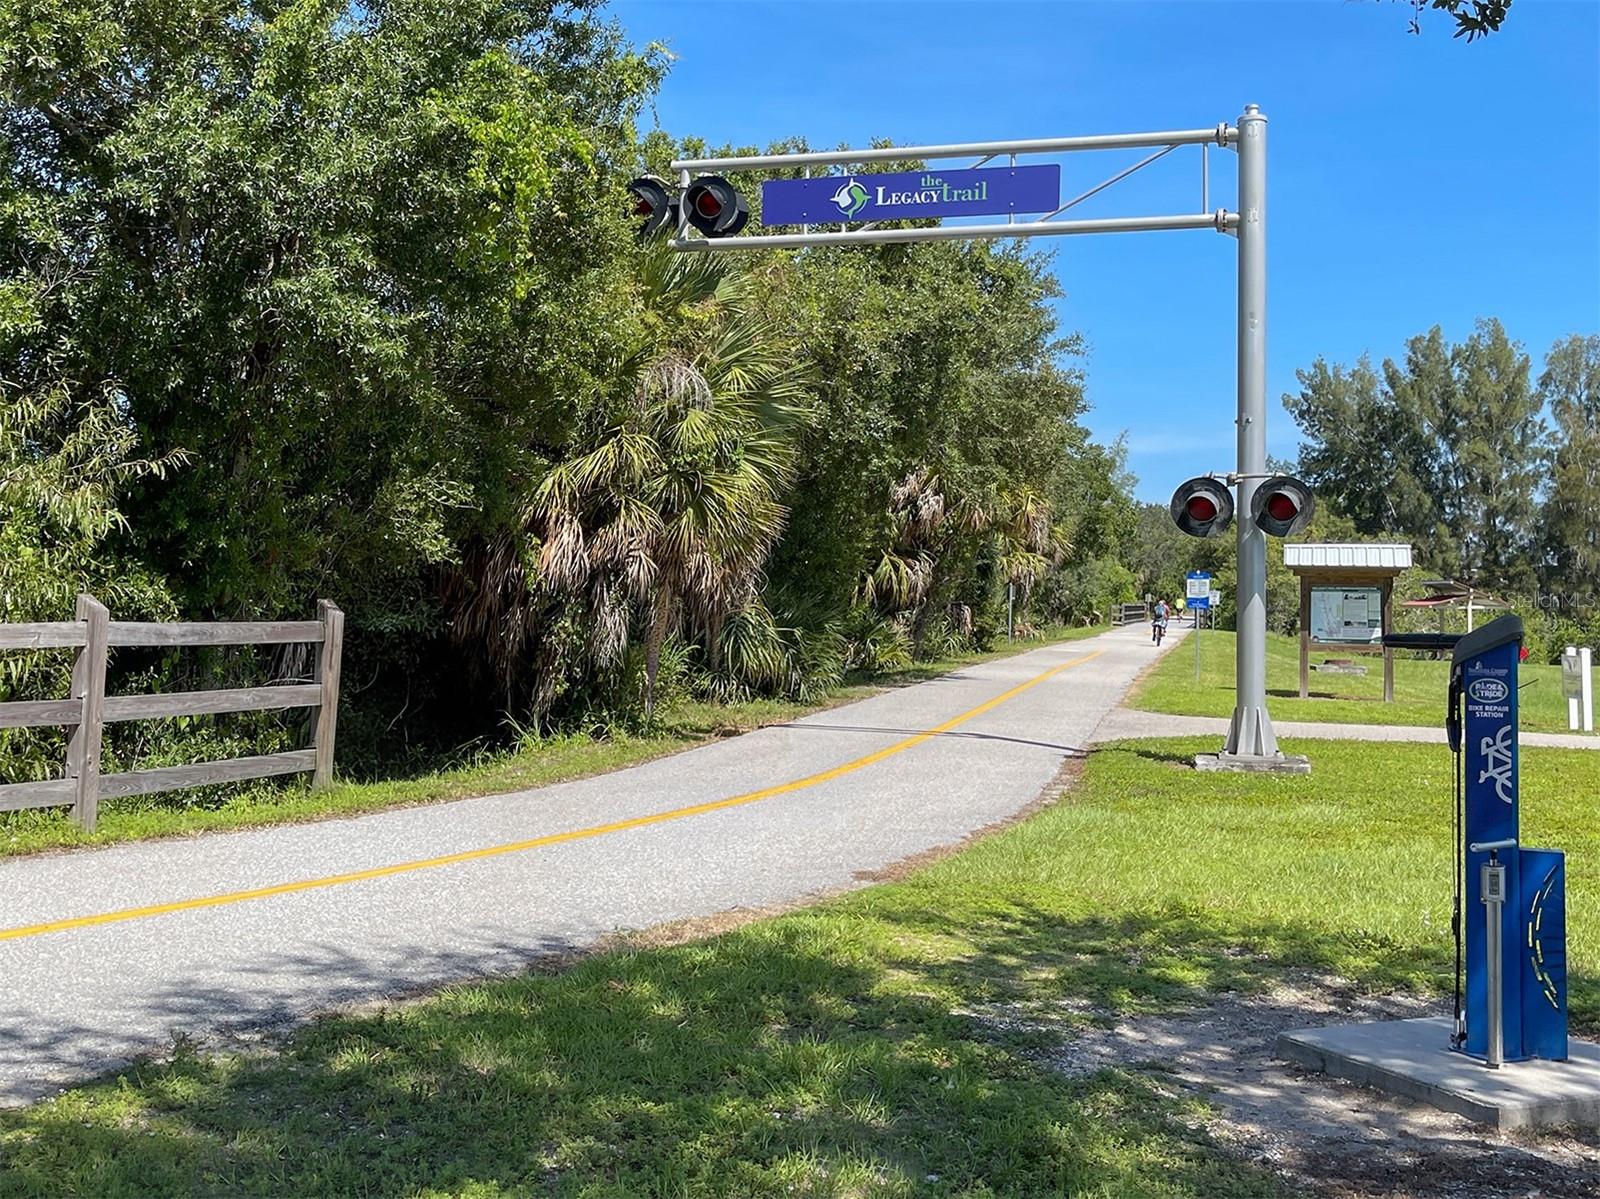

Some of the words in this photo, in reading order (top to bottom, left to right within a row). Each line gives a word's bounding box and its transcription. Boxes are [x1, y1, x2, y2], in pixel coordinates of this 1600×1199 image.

[920, 175, 943, 187] the
[874, 186, 941, 206] LEGACY
[942, 181, 988, 203] trail
[1468, 704, 1484, 712] BIKE
